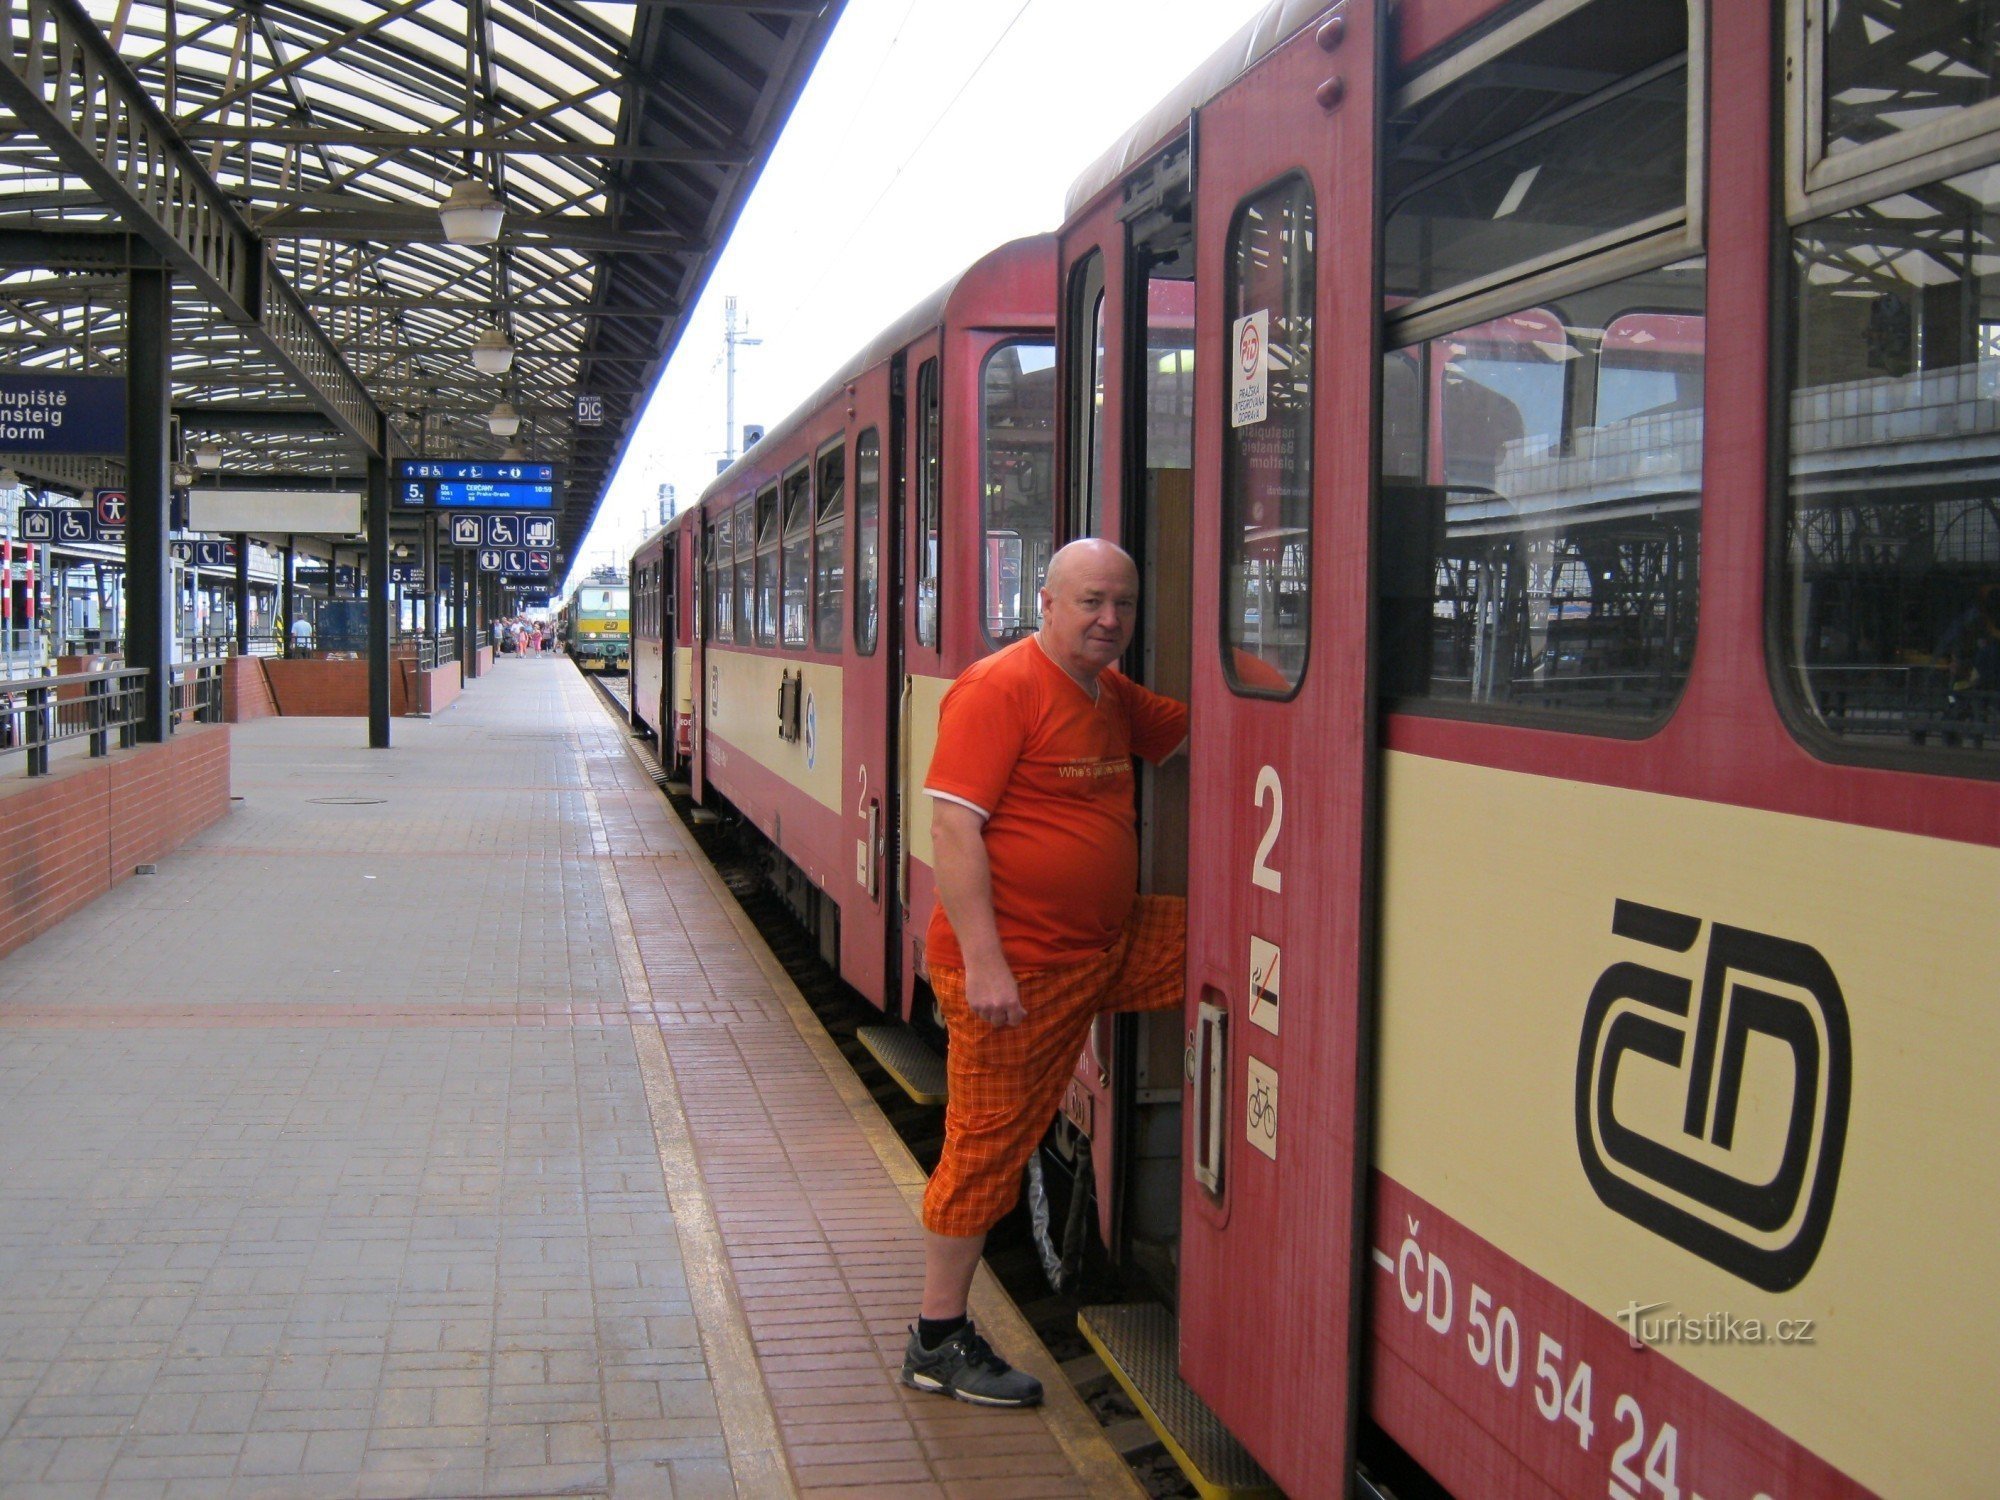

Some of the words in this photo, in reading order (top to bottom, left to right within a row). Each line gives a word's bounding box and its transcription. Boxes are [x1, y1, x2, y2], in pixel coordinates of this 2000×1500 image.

[0, 408, 62, 427] nsteig
[409, 484, 424, 498] 5.
[392, 569, 406, 581] 5.
[858, 764, 867, 820] 2
[1252, 765, 1283, 893] 2
[1467, 1282, 1520, 1388] 50
[1534, 1331, 1594, 1451] 54
[1609, 1393, 1680, 1500] 24
